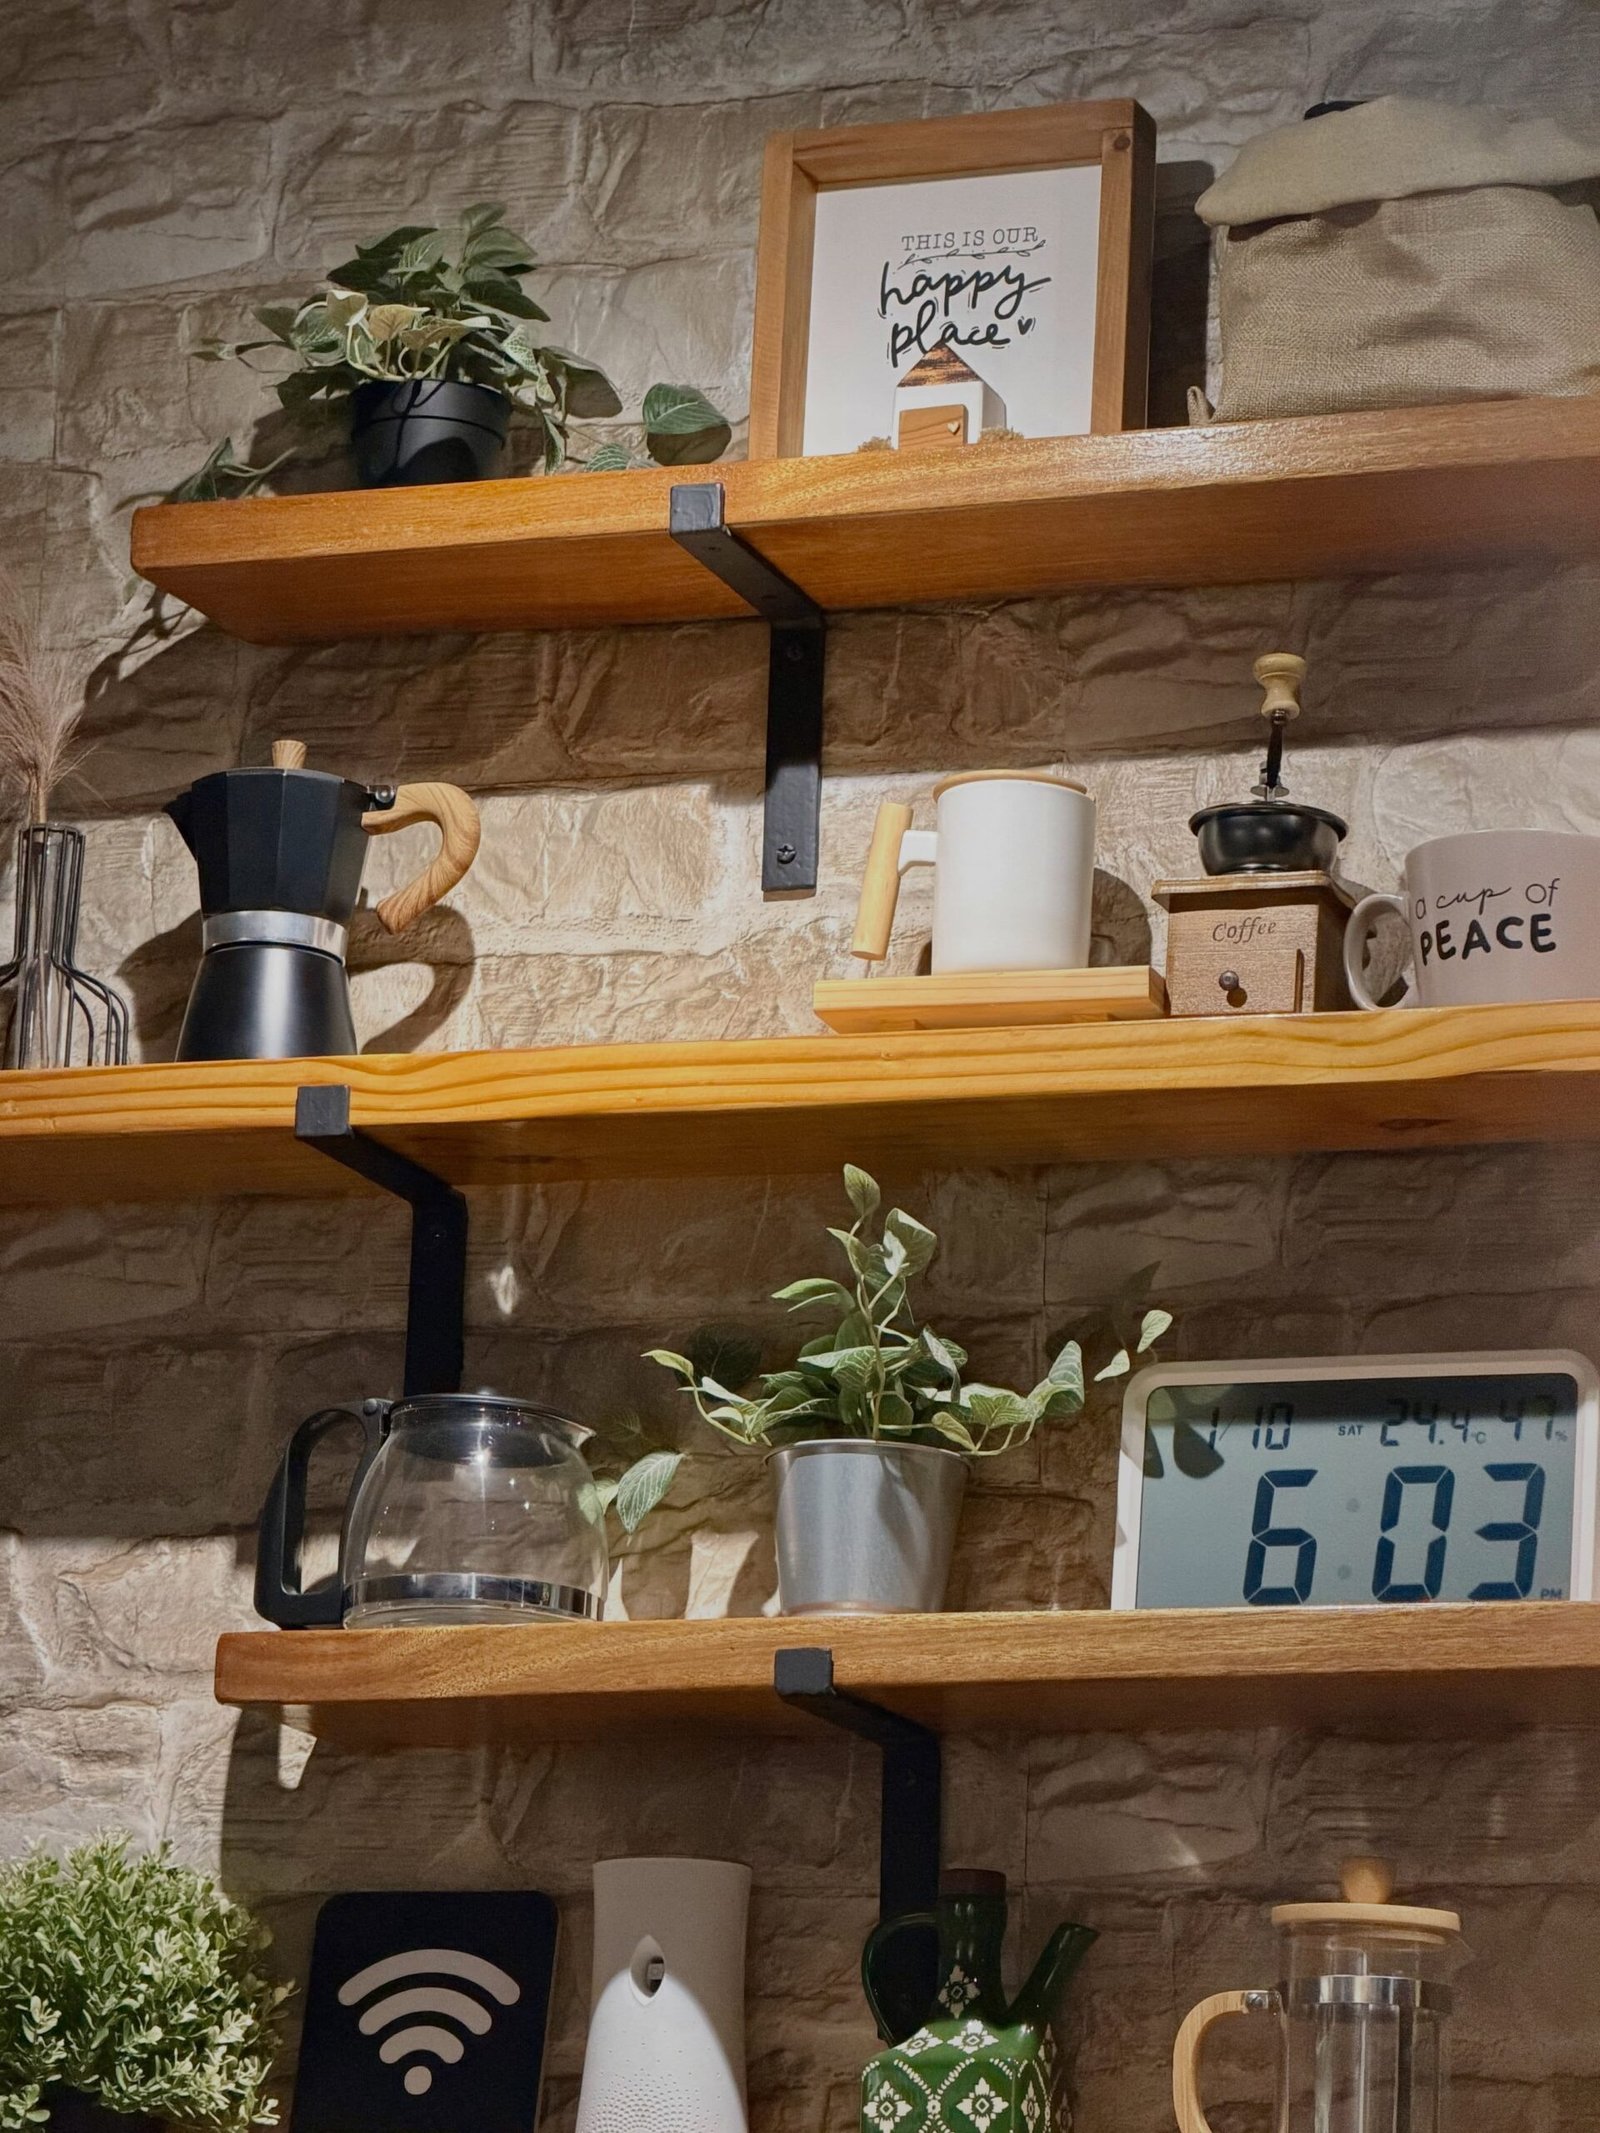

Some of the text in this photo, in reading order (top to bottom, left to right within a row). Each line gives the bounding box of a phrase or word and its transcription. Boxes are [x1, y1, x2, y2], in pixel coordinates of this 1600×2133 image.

[901, 226, 1039, 251] THIS IS OUR
[880, 261, 1052, 319] happy
[890, 299, 1011, 368] place
[1436, 886, 1513, 916] cup
[1212, 916, 1278, 945] Coffee
[1420, 913, 1557, 966] PEACE
[1338, 1424, 1364, 1437] SAT
[1541, 1588, 1563, 1600] PM
